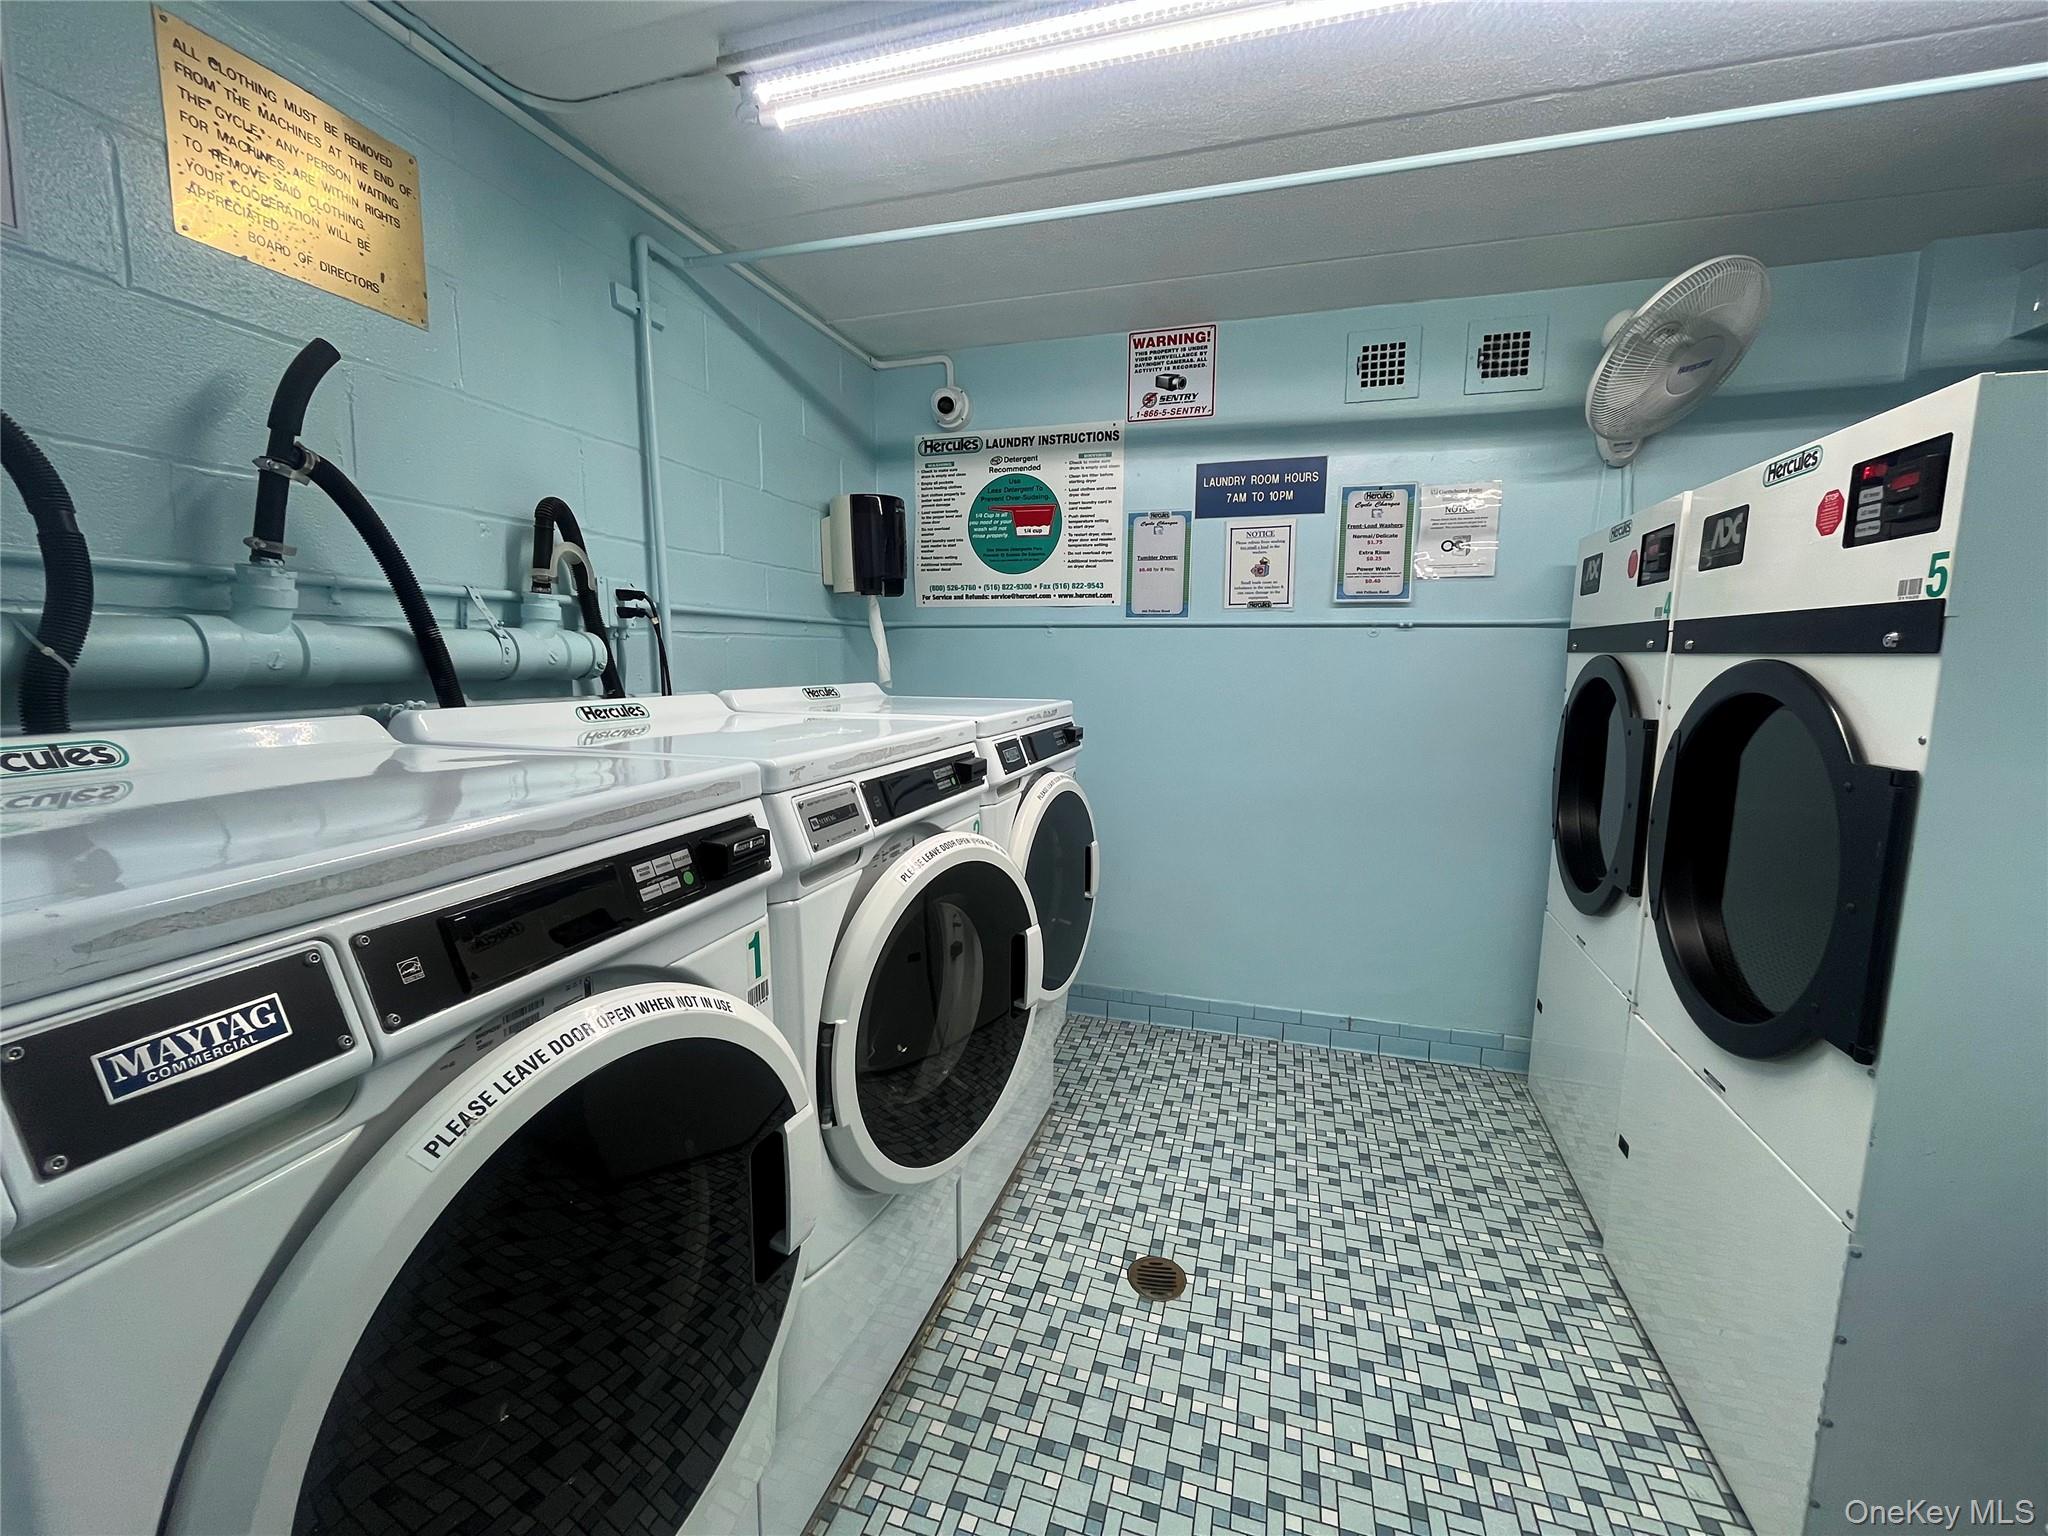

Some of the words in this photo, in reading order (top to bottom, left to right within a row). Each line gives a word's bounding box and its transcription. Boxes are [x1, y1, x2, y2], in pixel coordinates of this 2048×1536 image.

[172, 38, 200, 62] ALL
[208, 56, 277, 103] CLOTHING
[284, 98, 317, 124] MUST
[324, 121, 338, 137] BE
[344, 133, 392, 168] REMOVED
[175, 62, 216, 93] FROM
[224, 86, 250, 111] THE
[258, 105, 321, 149] MACHINES
[329, 145, 343, 162] AT
[348, 155, 368, 174] THE
[374, 170, 393, 188] END
[399, 183, 413, 198] OF
[177, 86, 206, 110] THE
[307, 154, 351, 185] PERSON
[357, 181, 398, 209] WAITING
[180, 110, 208, 134] FOR
[217, 128, 286, 172] MACHINES
[292, 167, 315, 186] ARE
[321, 181, 359, 207] WITHIN
[365, 202, 400, 228] RIGHTS
[183, 134, 202, 153] TO
[211, 148, 267, 183] REMOVE
[273, 178, 301, 199] SAID
[185, 159, 224, 186] YOUR
[230, 181, 320, 228] COOPERATION
[326, 225, 352, 244] WILL
[358, 237, 370, 252] BE
[248, 231, 291, 256] BOARD
[298, 251, 313, 266] OF
[320, 261, 380, 293] DIRECTORS
[1133, 331, 1210, 349] WARNING!
[1154, 352, 1197, 360] SURVEILLANCE
[1160, 393, 1199, 402] SENTRY
[1137, 406, 1207, 418] 1-866-5-SENTRY
[924, 438, 979, 453] Hercules
[986, 436, 1035, 449] LAUNDRY
[1038, 431, 1120, 445] INSTRUCTIONS
[989, 464, 1041, 473] Recommended
[1004, 455, 1038, 463] Detergent
[1768, 451, 1818, 481] Hercules
[1204, 476, 1246, 487] LAUNDRY
[1251, 474, 1279, 485] ROOM
[1285, 471, 1319, 482] HOURS
[1252, 492, 1264, 502] TO
[1825, 493, 1838, 502] STOP
[1926, 551, 1950, 597] 5
[1664, 592, 1671, 618] 4
[805, 687, 837, 699] Hercules
[580, 704, 645, 720] Hercules
[922, 847, 941, 862] LEAVE
[940, 840, 956, 852] DOOR
[749, 931, 761, 979] 1
[105, 1002, 279, 1084] MAYTAG
[146, 1035, 258, 1083] COMMERCIAL
[423, 1093, 498, 1159] PLEASE
[493, 1048, 553, 1095] LEAVE
[548, 1022, 596, 1056] DOOR
[596, 1007, 636, 1029] OPEN
[635, 998, 674, 1016] WHEN
[676, 996, 699, 1009] NOT
[700, 997, 712, 1009] IN
[714, 999, 733, 1013] USE
